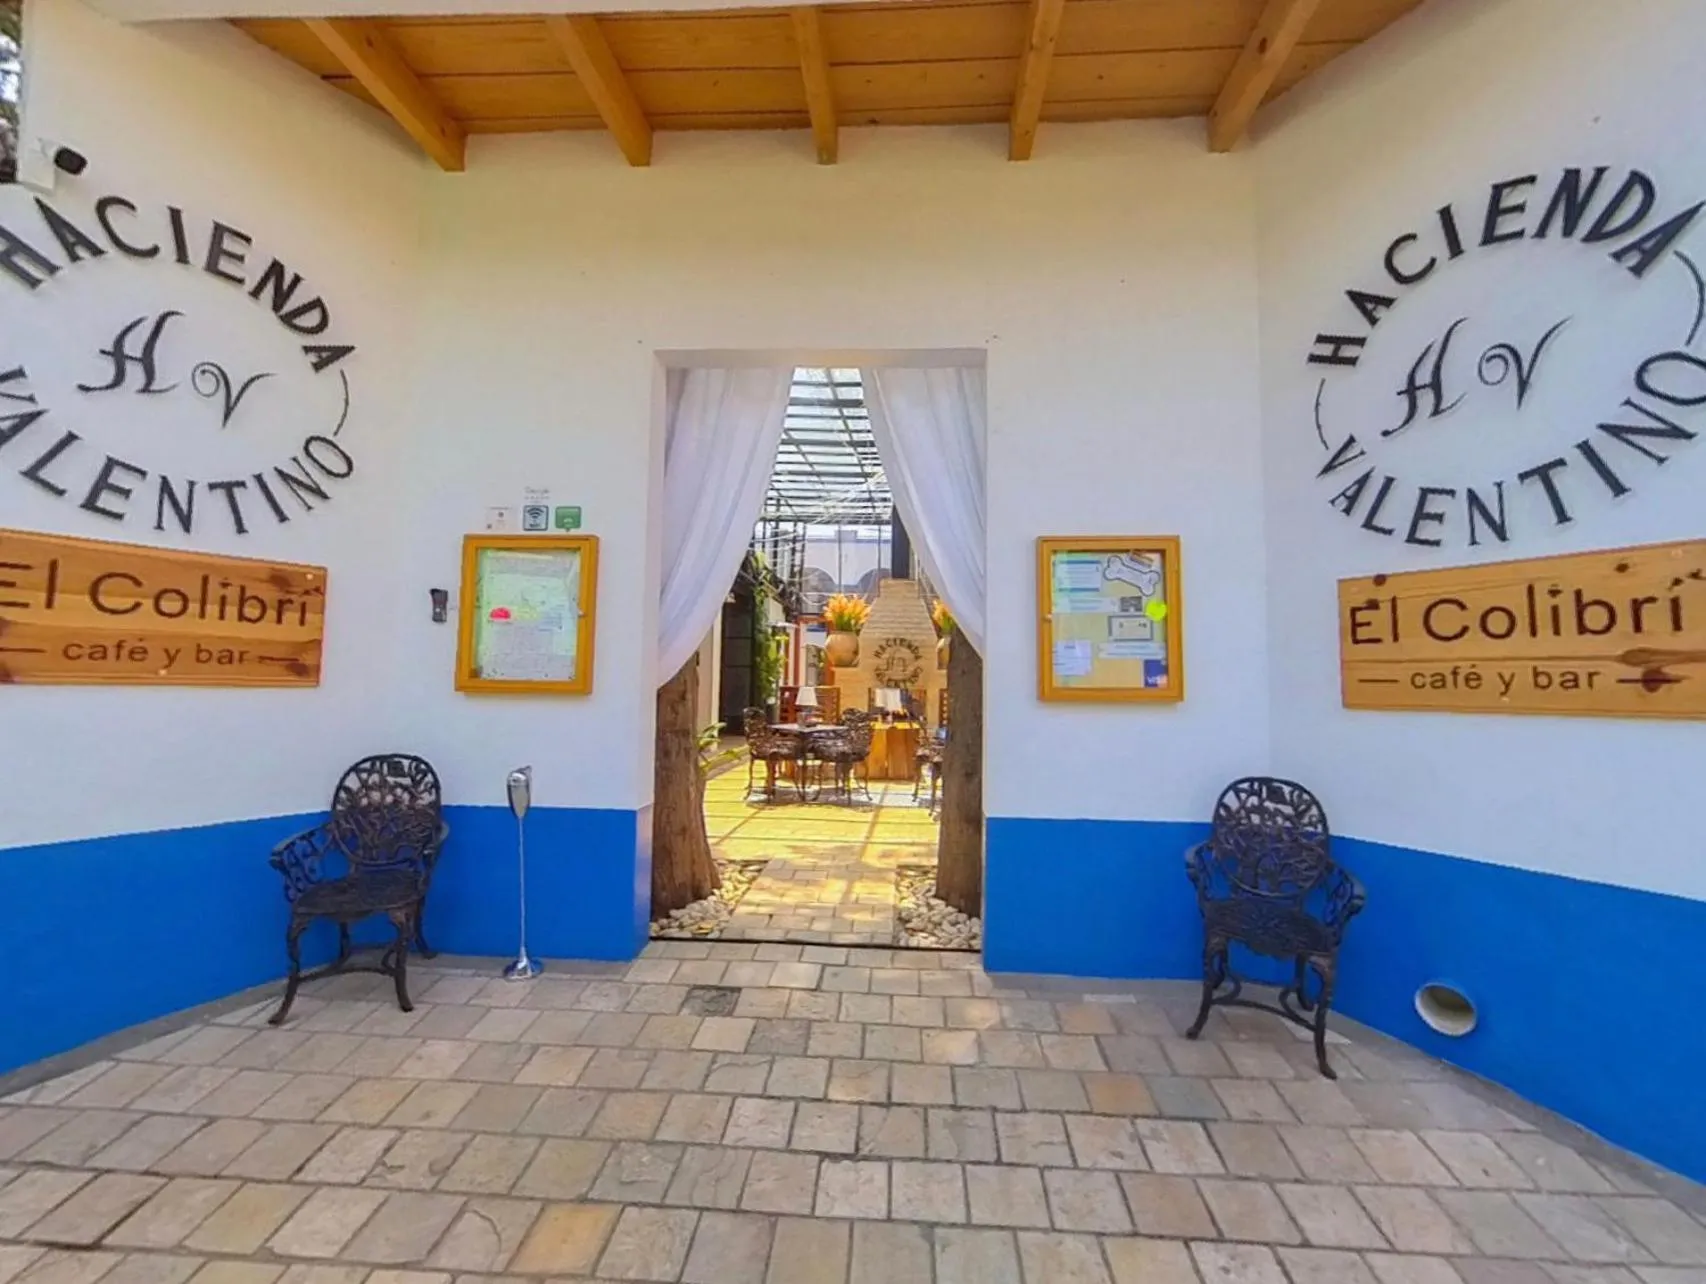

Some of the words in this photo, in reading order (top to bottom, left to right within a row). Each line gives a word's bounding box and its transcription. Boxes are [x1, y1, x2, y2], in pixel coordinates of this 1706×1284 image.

[0, 196, 356, 373] HACIENDA
[1306, 166, 1706, 368] HACIENDA
[1316, 351, 1706, 546] VALENTINO
[0, 558, 59, 610] El
[89, 573, 322, 627] Colibrí
[1350, 596, 1399, 645] El
[1422, 576, 1690, 642] Colibrí
[63, 637, 149, 663] café
[154, 647, 181, 669] y
[195, 642, 250, 666] bar
[1410, 664, 1482, 690] café
[1499, 671, 1515, 695] y
[1533, 666, 1602, 690] bar
